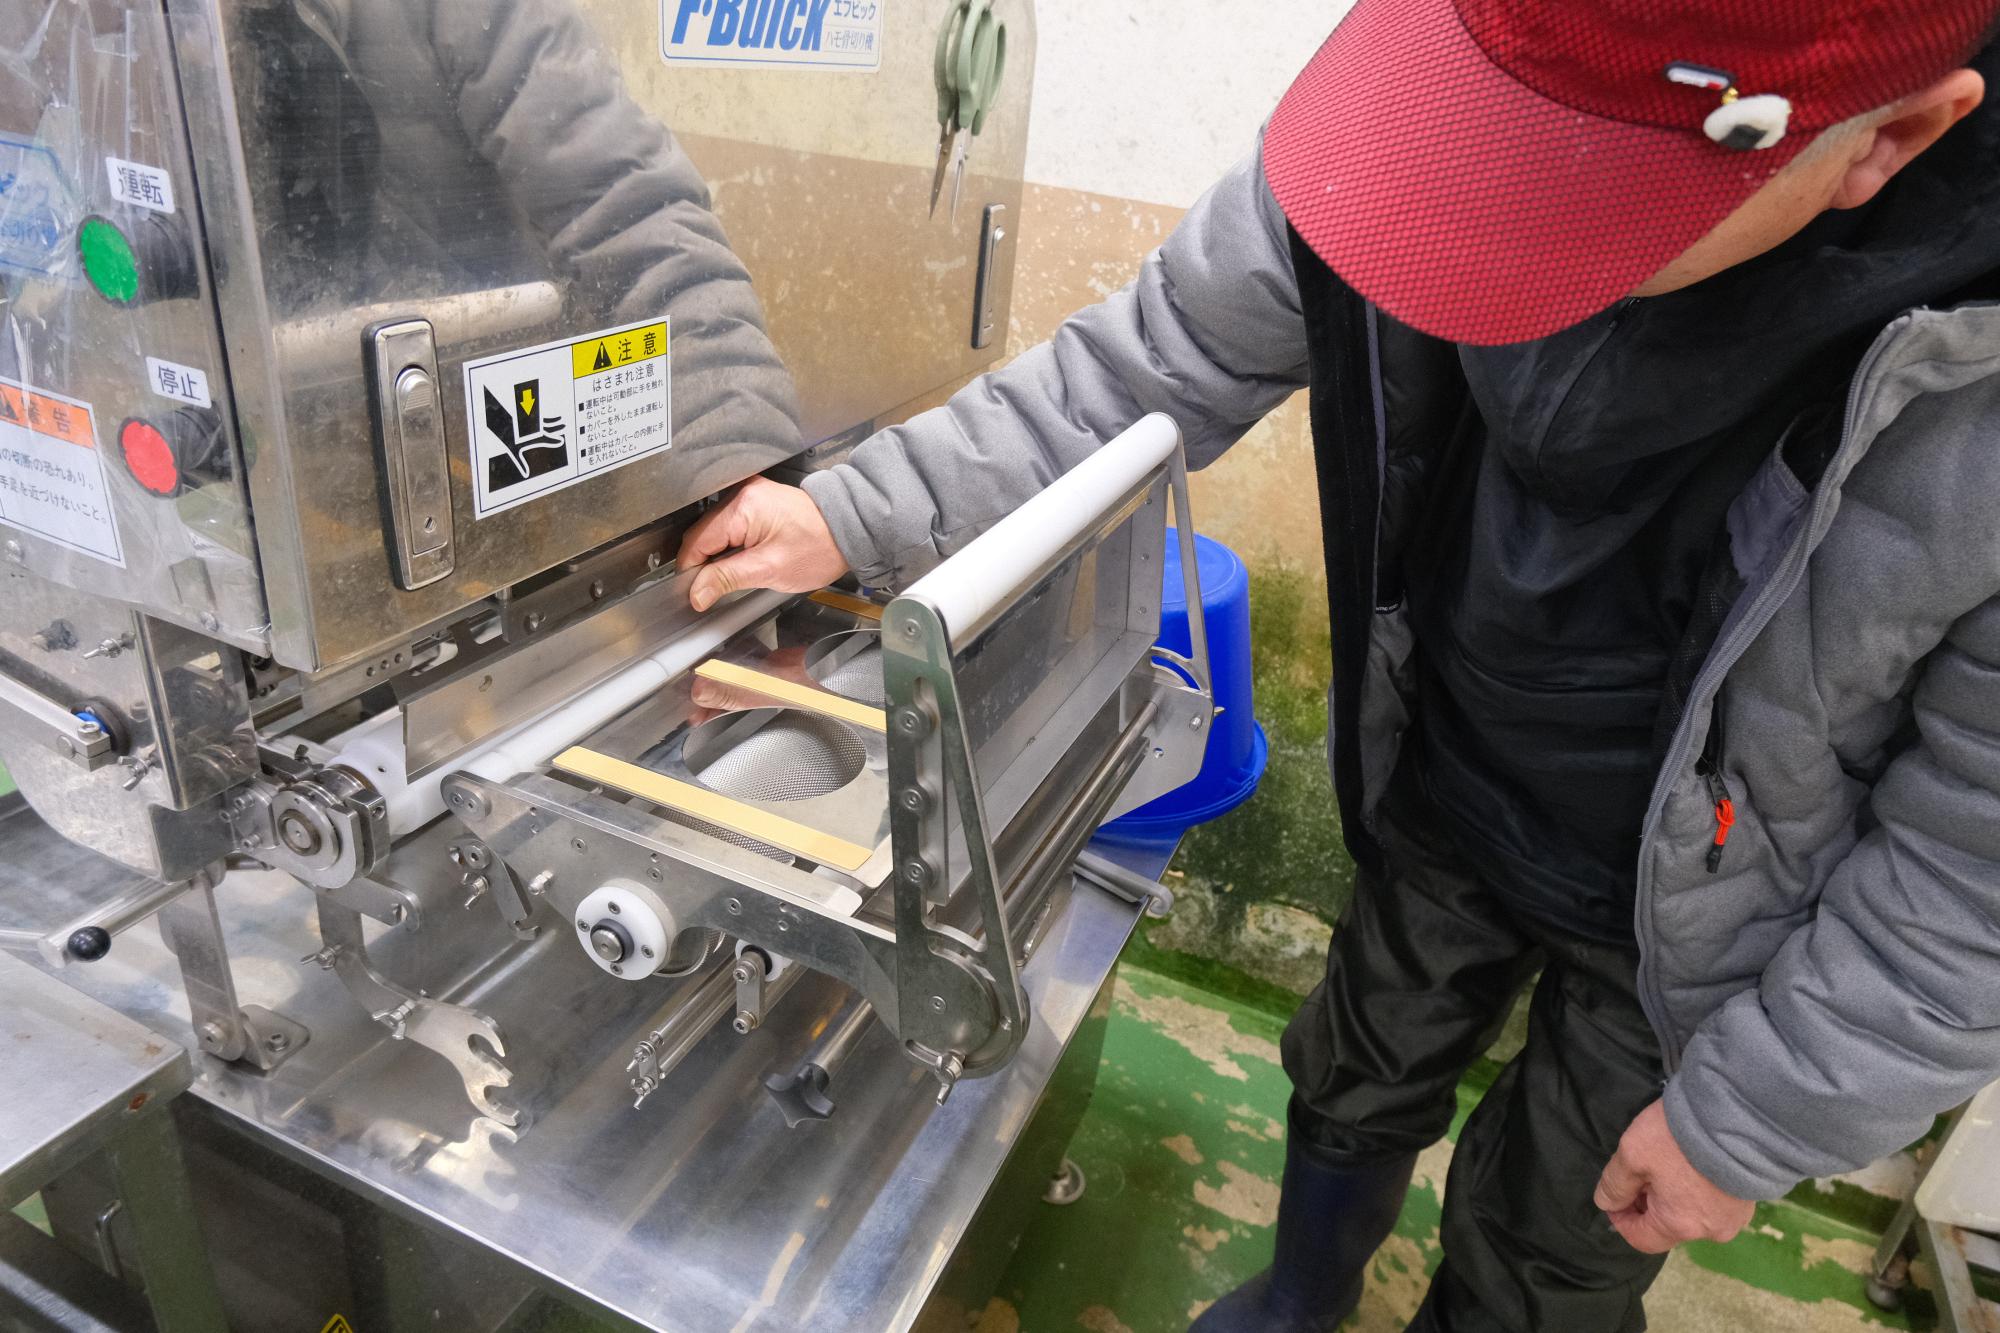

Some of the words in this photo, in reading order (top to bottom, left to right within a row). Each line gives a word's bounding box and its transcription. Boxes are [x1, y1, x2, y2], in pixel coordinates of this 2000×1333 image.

[116, 165, 164, 206] 運転
[618, 331, 656, 362] 注意
[158, 365, 202, 401] 停止
[592, 363, 655, 392] はさまれ注意
[585, 379, 664, 410] 運転中は可動部に手を触れ
[587, 401, 664, 433] カバーを外したまま運転し
[587, 421, 664, 456] 運転中はカバーの内側に手
